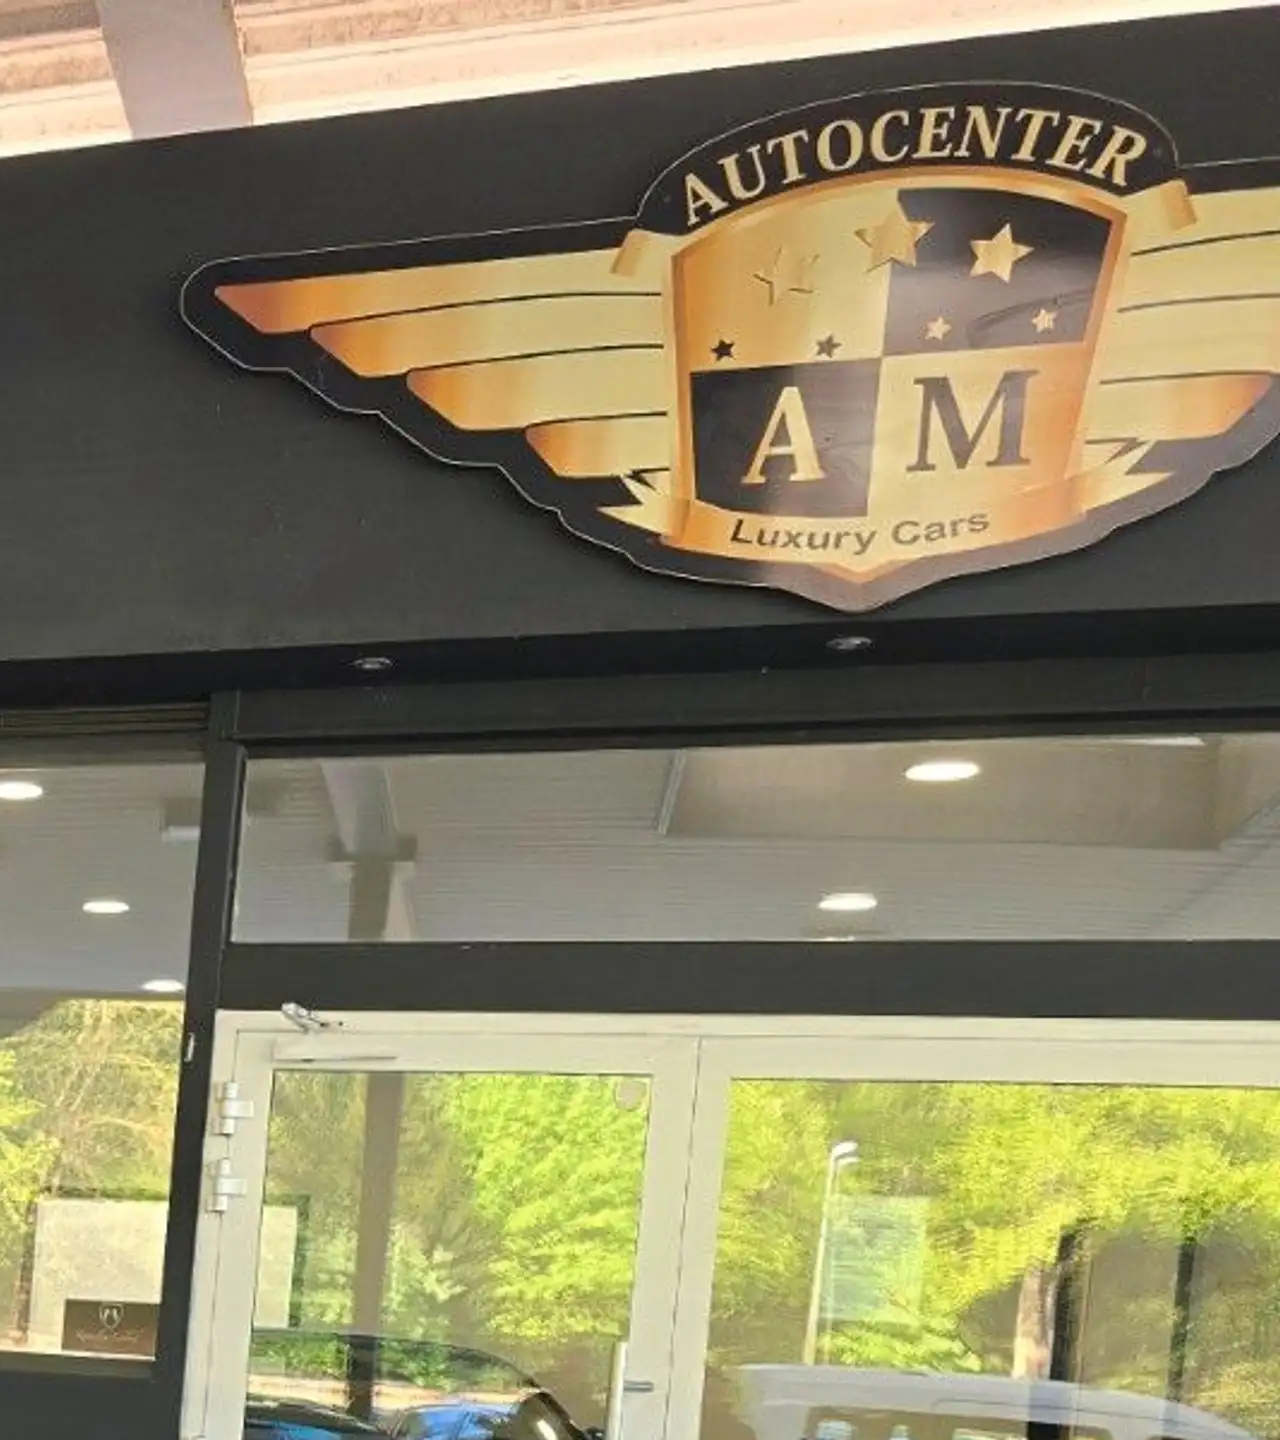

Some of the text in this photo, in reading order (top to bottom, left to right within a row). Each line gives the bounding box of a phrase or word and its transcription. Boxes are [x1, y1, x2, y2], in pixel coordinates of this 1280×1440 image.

[686, 104, 1148, 227] AUTOCENTER
[730, 513, 991, 556] Luxury Cars
